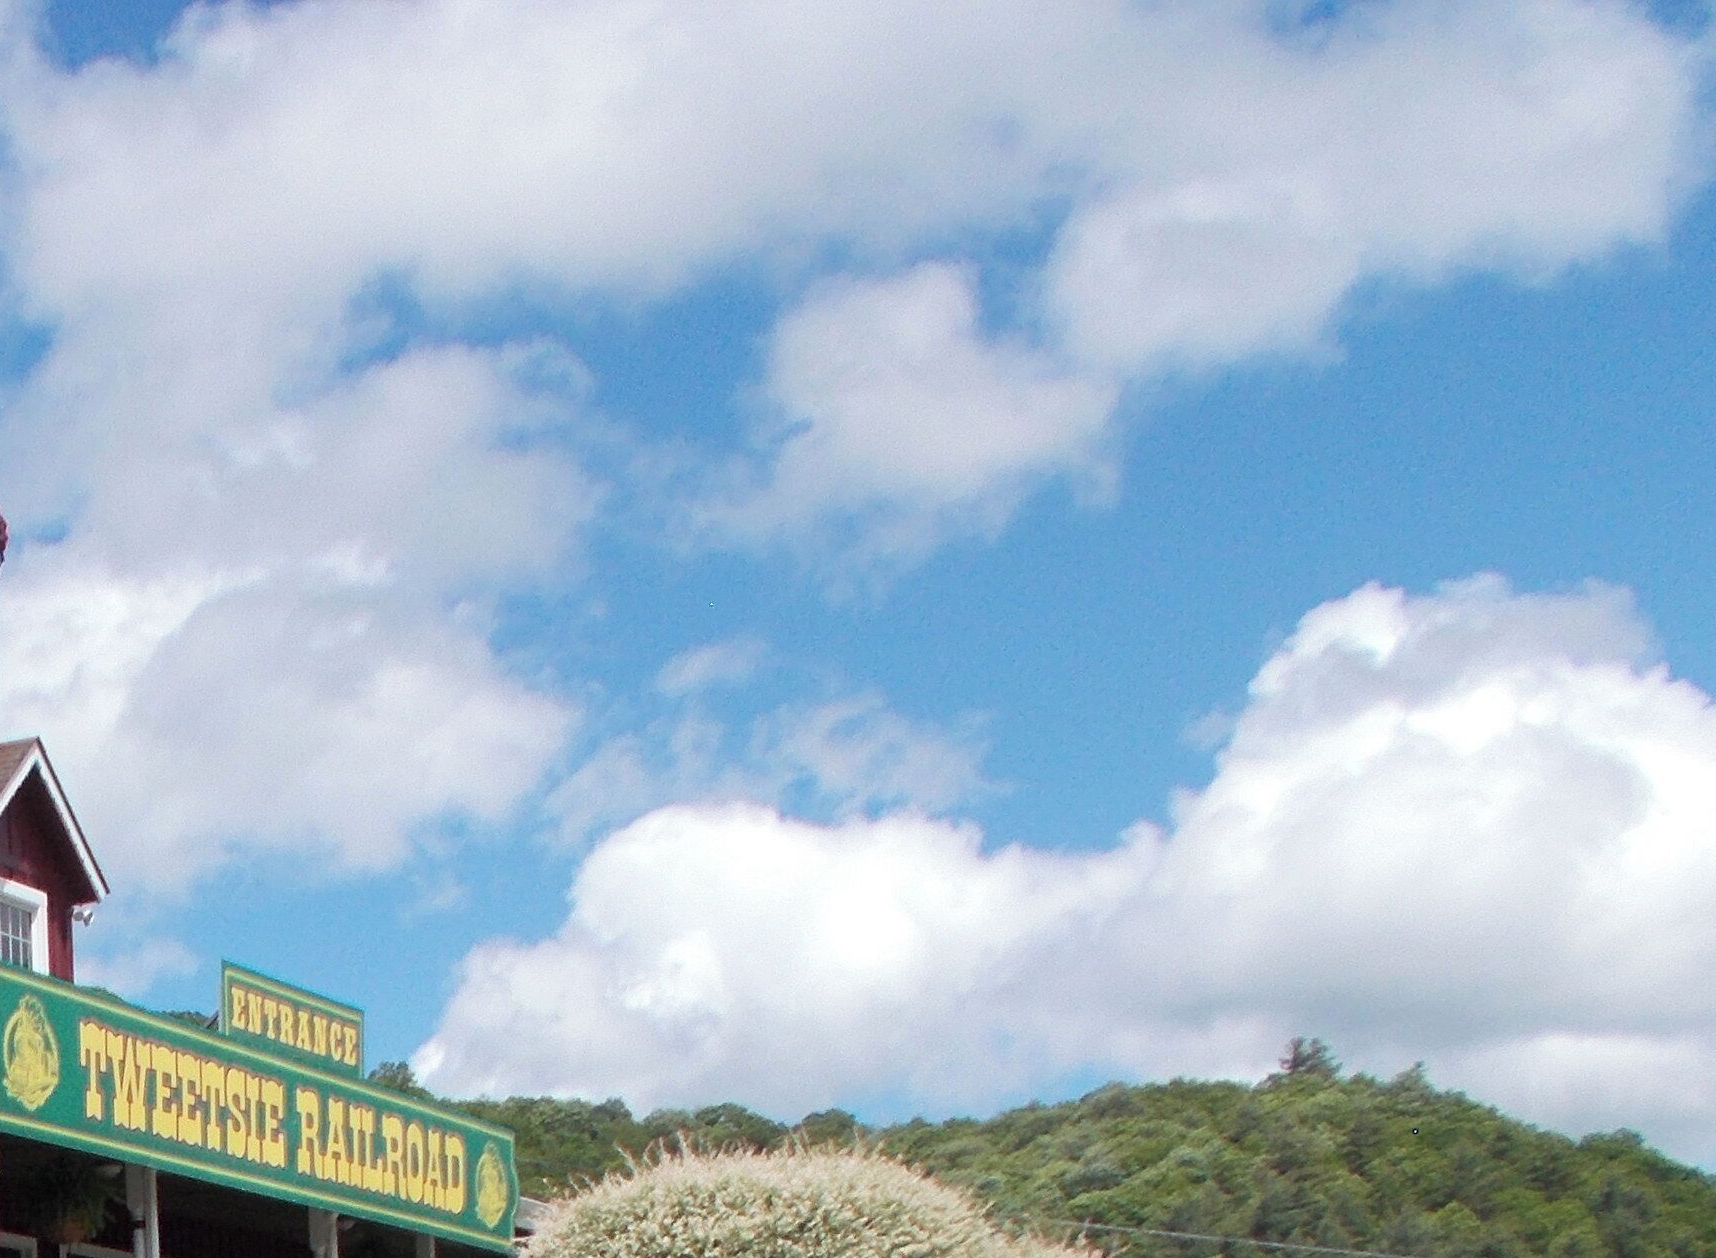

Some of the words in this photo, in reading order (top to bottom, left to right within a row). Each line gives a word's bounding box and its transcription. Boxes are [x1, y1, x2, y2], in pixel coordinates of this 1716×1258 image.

[230, 986, 359, 1067] ENTRANCE
[79, 1019, 286, 1169] TWEETSIE
[295, 1085, 467, 1215] RAILROAD
